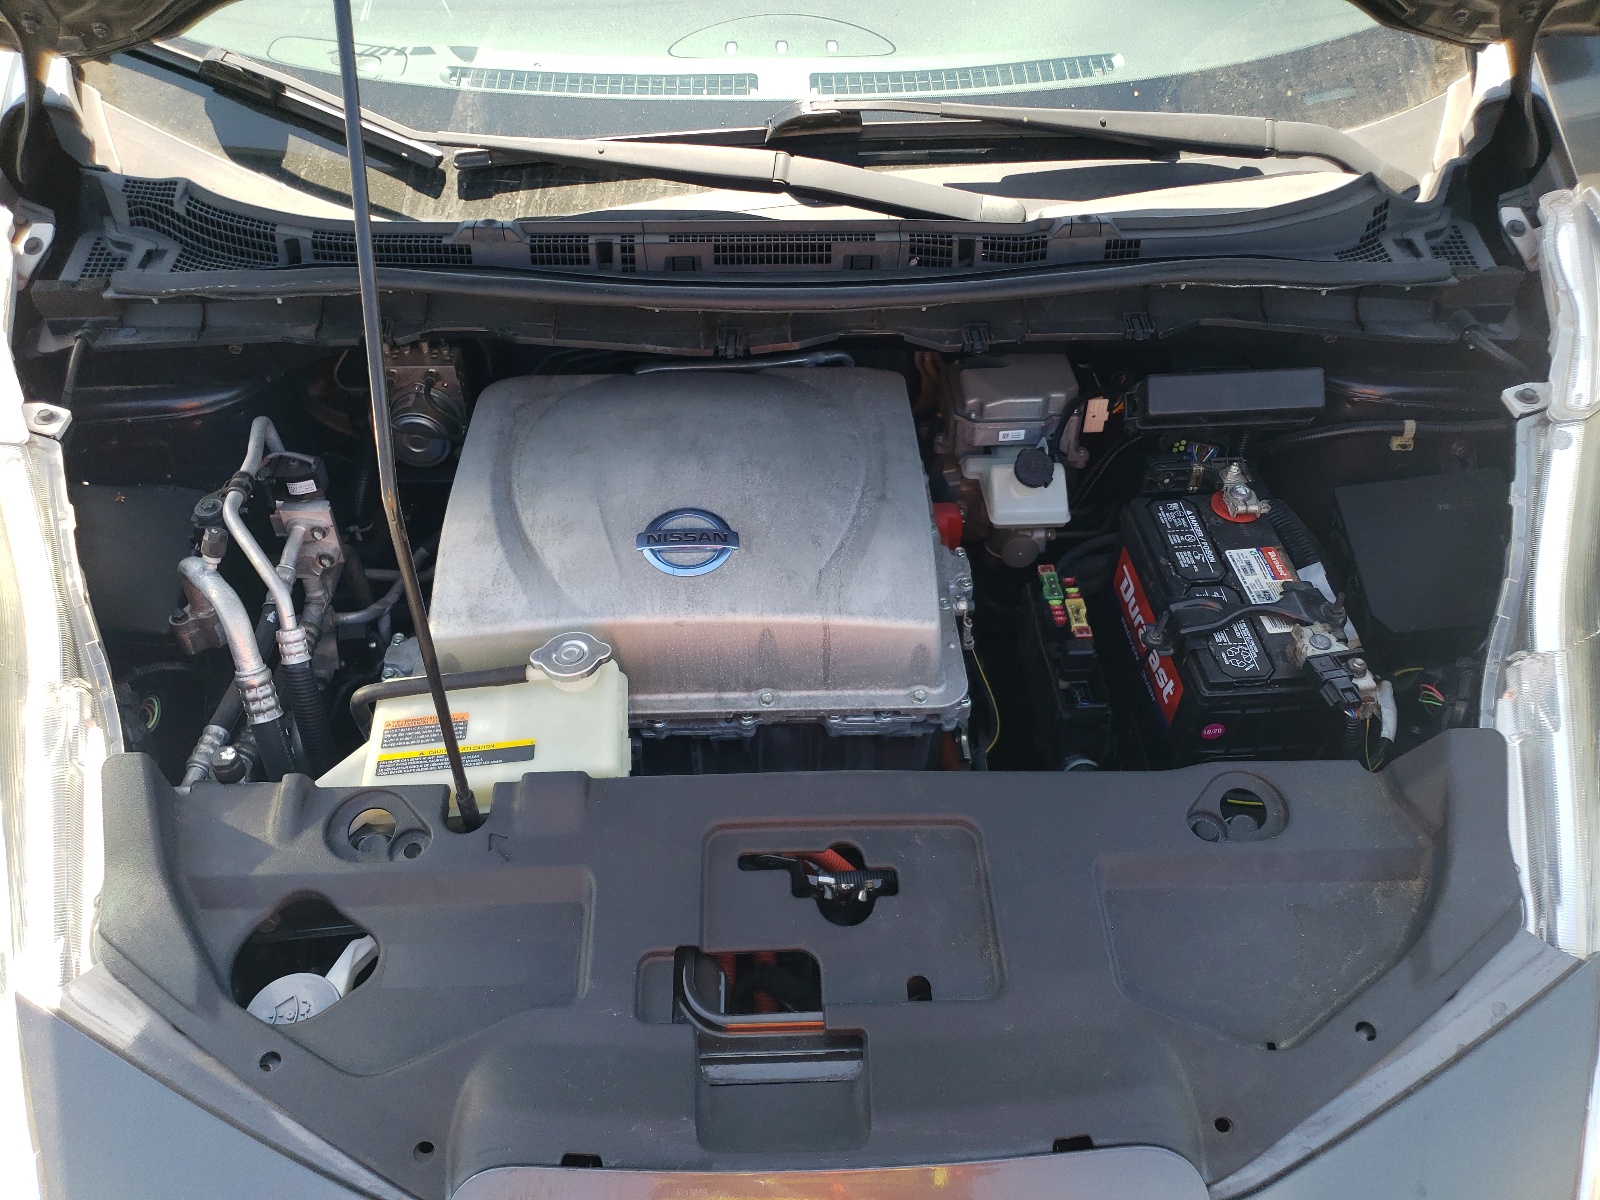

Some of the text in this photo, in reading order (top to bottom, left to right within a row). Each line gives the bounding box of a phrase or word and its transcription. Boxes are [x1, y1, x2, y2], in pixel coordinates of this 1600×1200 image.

[646, 532, 729, 544] NISSAN
[1189, 515, 1204, 541] DANGER
[1201, 541, 1216, 563] POISON
[1119, 564, 1174, 704] Duraast
